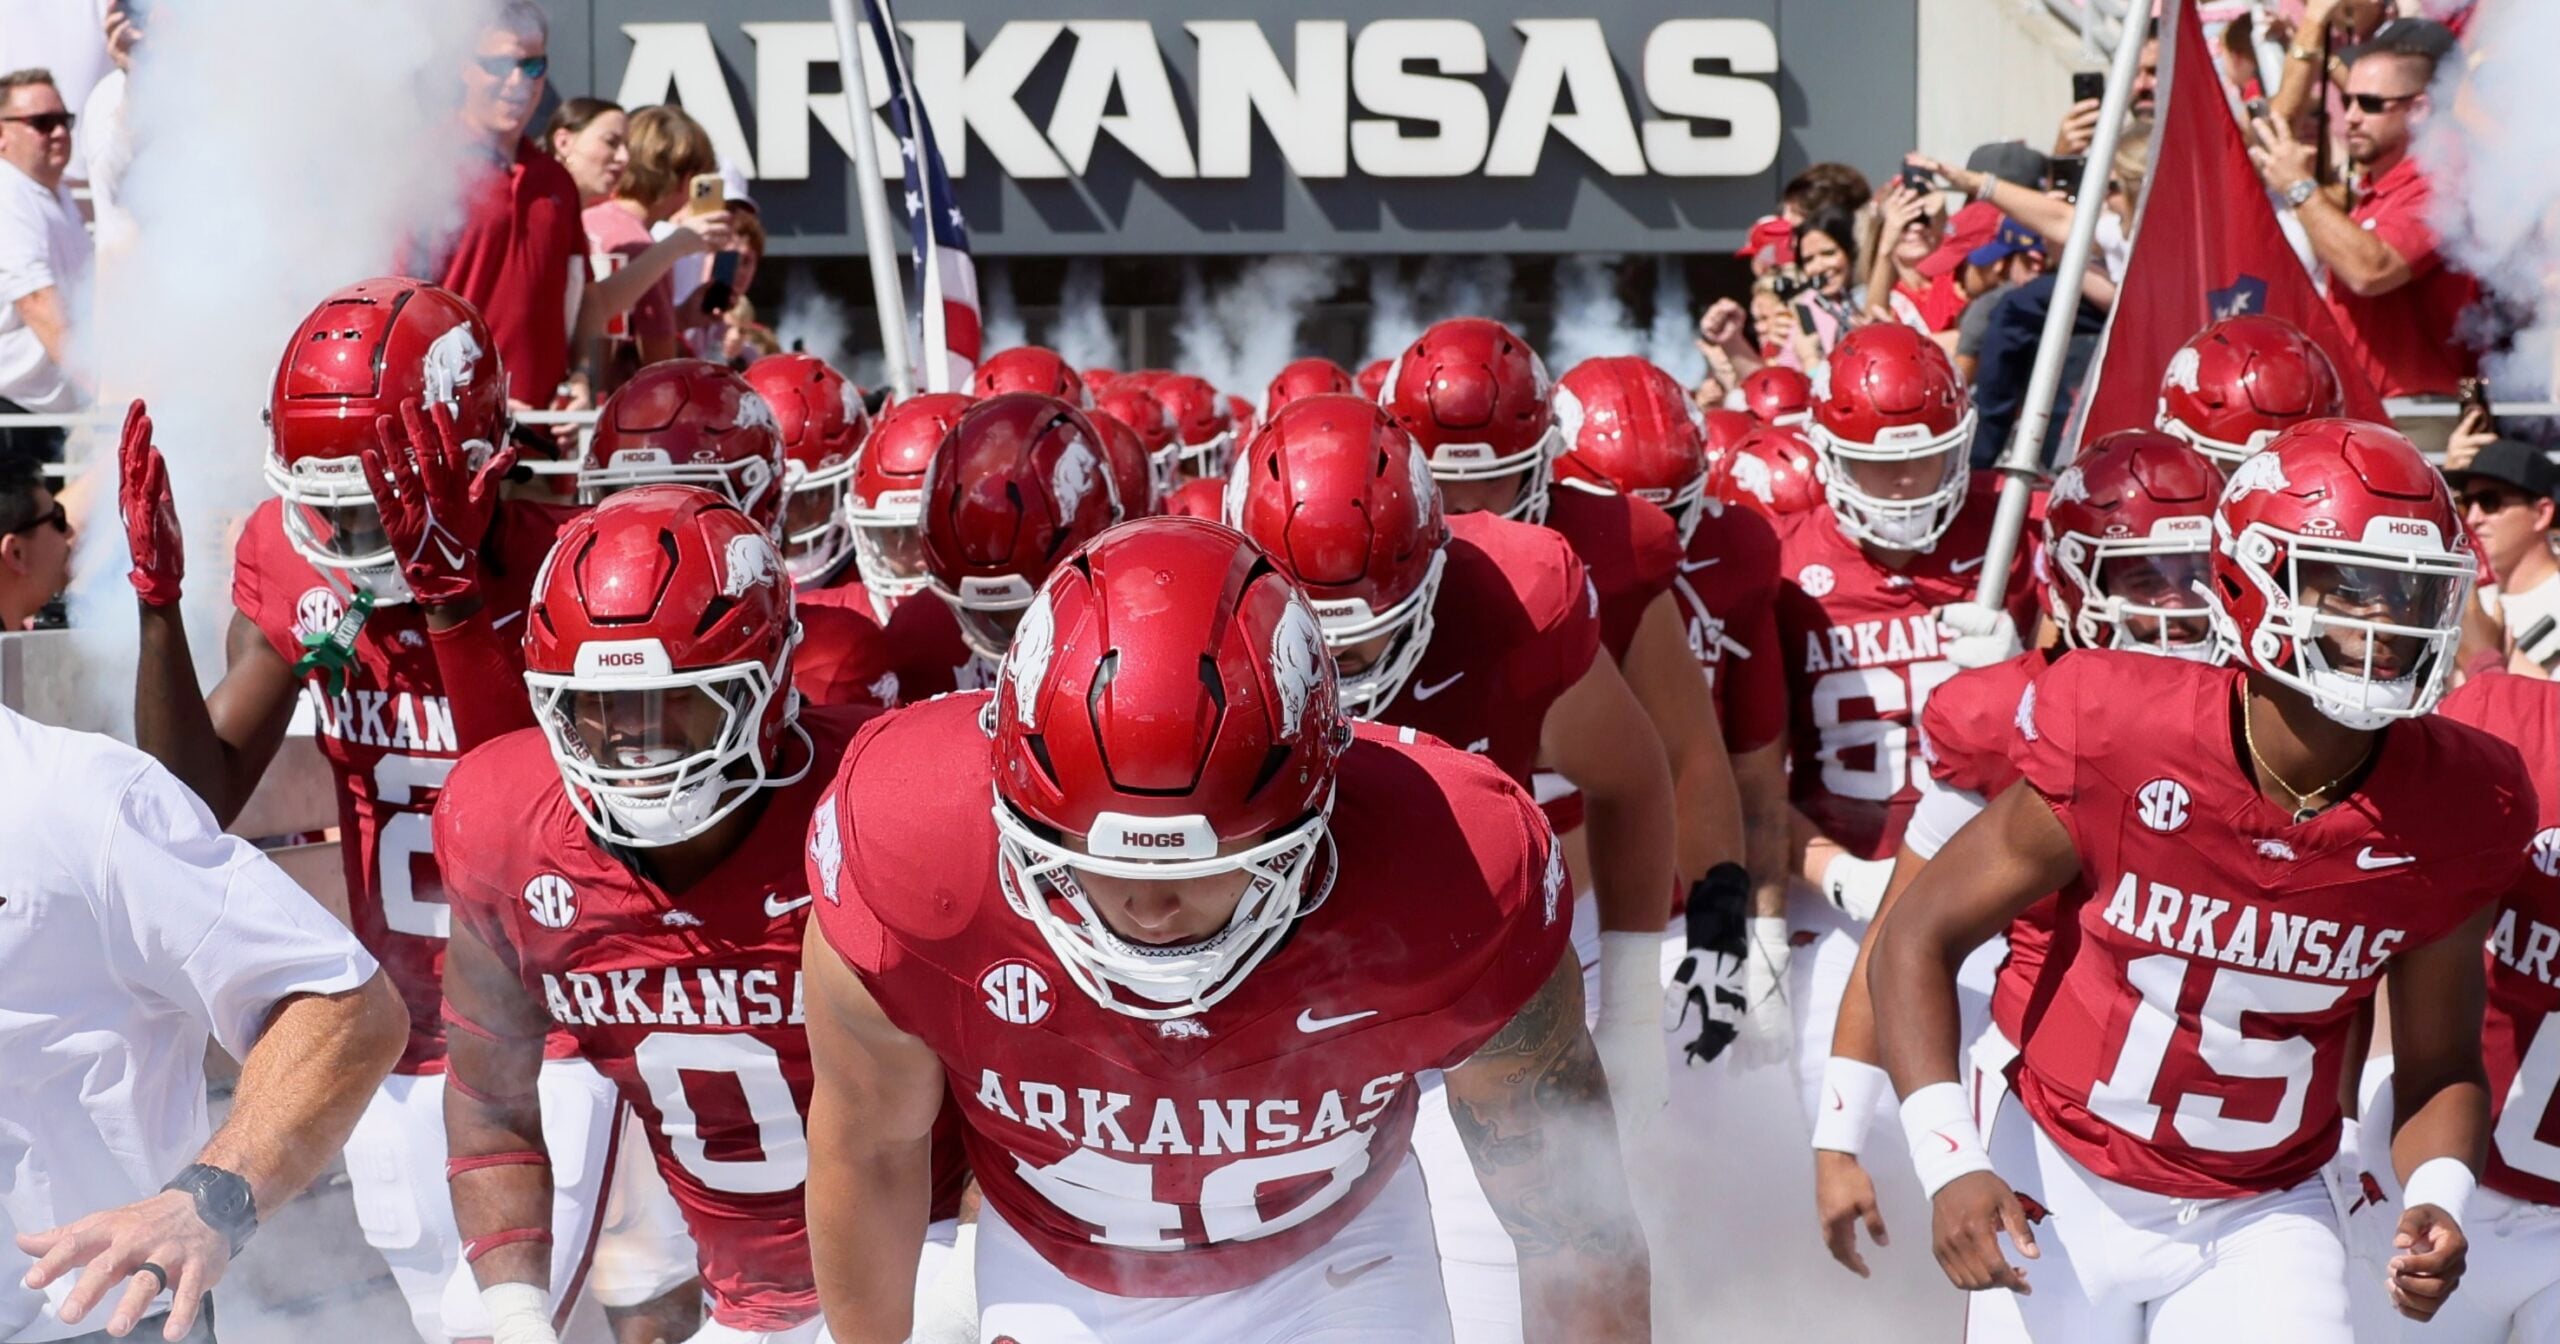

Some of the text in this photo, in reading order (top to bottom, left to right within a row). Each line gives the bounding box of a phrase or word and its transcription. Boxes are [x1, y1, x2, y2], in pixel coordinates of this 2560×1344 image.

[617, 18, 1781, 180] ARKANSAS
[621, 451, 656, 463] HOGS
[2169, 521, 2202, 531] HOGS
[2388, 521, 2429, 536] HOGS
[301, 589, 343, 634] SEC
[598, 652, 645, 667] HOGS
[2136, 779, 2191, 832] SEC
[1122, 830, 1185, 848] HOGS
[522, 873, 578, 928] SEC
[2103, 872, 2405, 980] ARKANSAS
[2485, 908, 2560, 989] AR
[982, 963, 1050, 1024] SEC
[2088, 953, 2349, 1153] 15
[635, 1032, 809, 1194] 0
[976, 1069, 1405, 1156] ARKANSAS
[1009, 1123, 1376, 1252] 40
